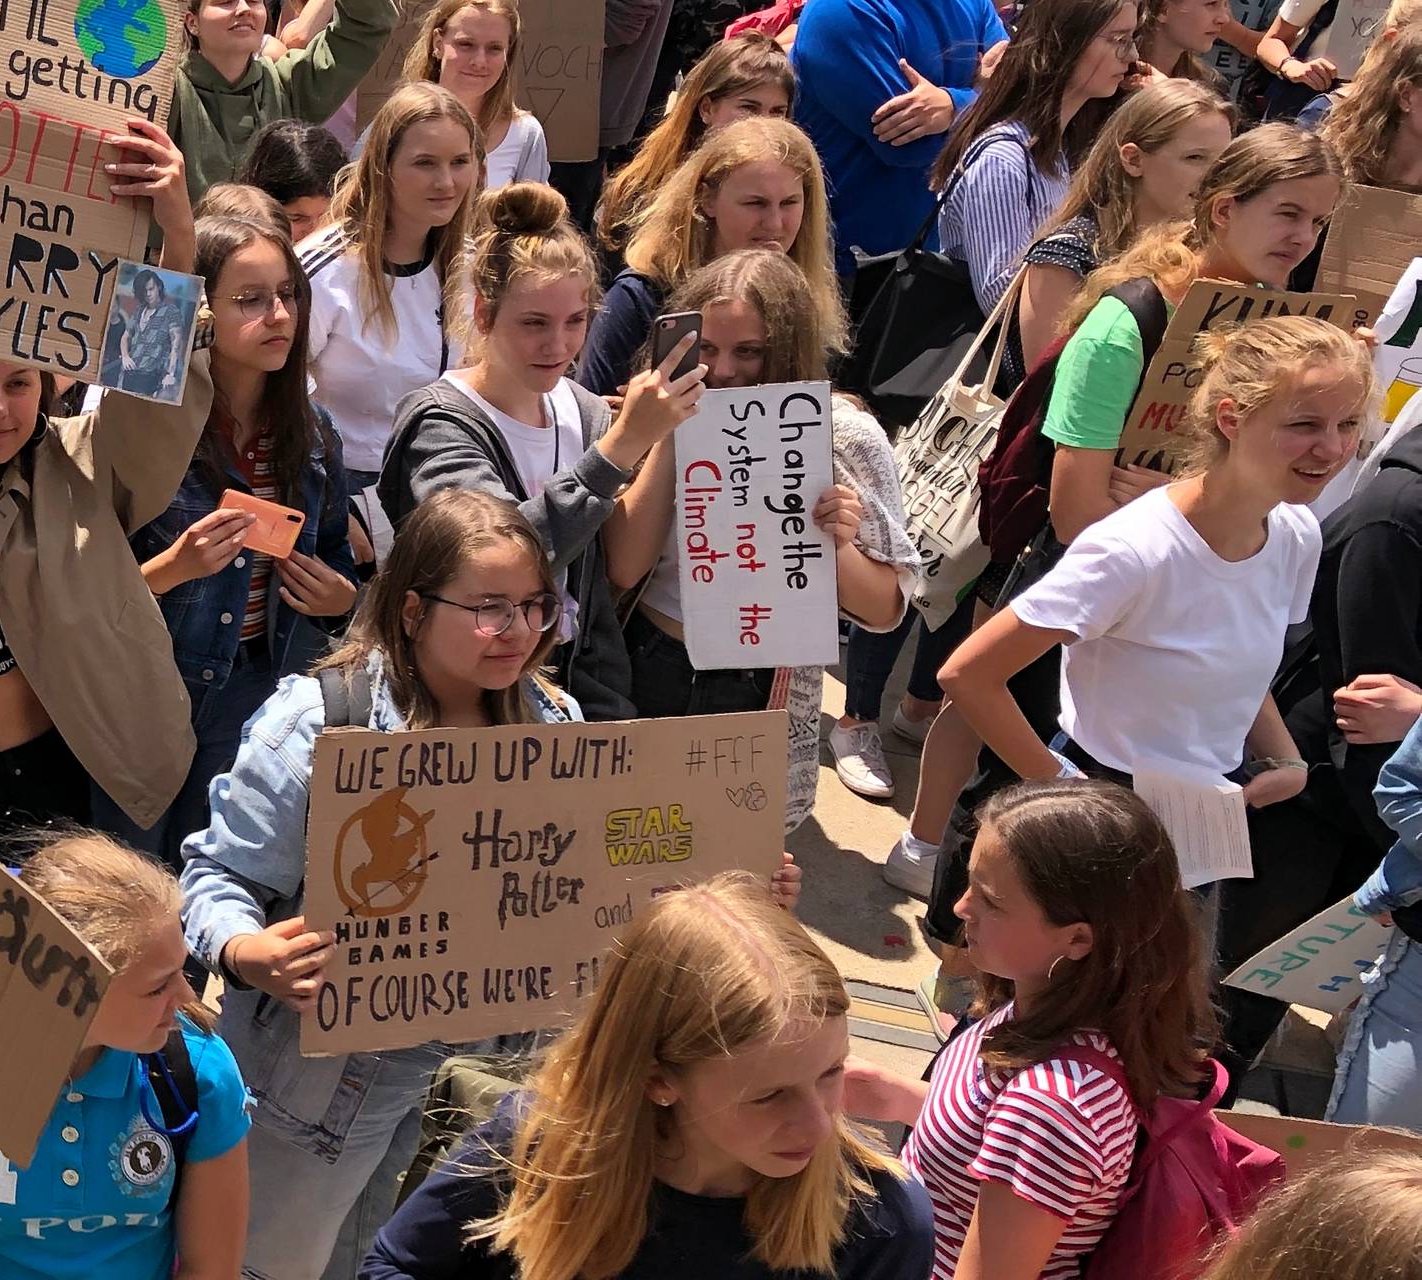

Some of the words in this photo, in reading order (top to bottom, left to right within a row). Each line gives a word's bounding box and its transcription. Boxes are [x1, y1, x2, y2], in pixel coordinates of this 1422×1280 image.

[5, 50, 159, 123] getting
[722, 400, 766, 507] System
[763, 392, 822, 536] Change
[684, 460, 730, 584] Climate
[735, 523, 766, 572] not
[782, 541, 823, 590] the
[738, 603, 772, 646] the
[335, 744, 389, 794] WE
[397, 739, 476, 790] GREW
[494, 736, 542, 783] UP
[551, 735, 634, 781] WITH:
[462, 808, 576, 871] Harry
[604, 803, 693, 843] STAR
[605, 839, 693, 867] WARS
[497, 870, 585, 931] Potter
[594, 893, 633, 929] and
[335, 910, 450, 945] HUNGER
[348, 939, 448, 966] GAMES
[482, 965, 553, 1005] WE'RE
